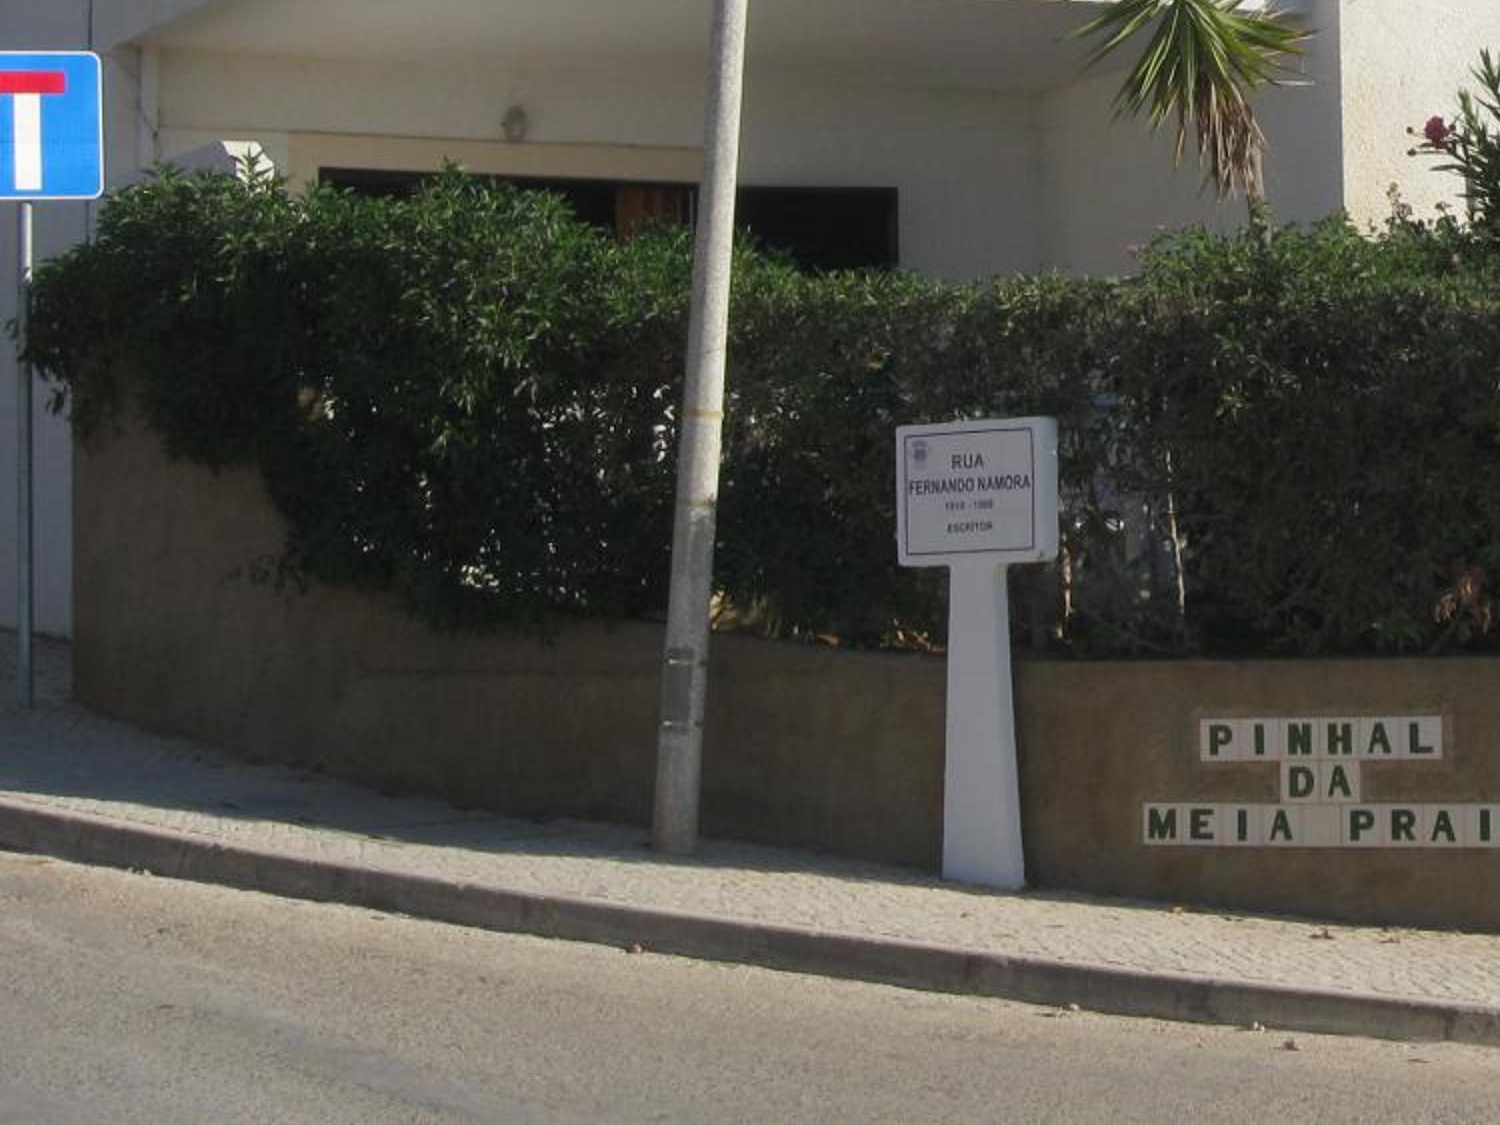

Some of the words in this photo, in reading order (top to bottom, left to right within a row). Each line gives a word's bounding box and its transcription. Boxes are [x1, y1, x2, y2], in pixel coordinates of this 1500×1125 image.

[951, 454, 984, 469] RUA
[909, 478, 975, 495] FERNANDO
[977, 475, 1030, 492] NAMORA
[947, 521, 993, 533] ESCRITOR
[1208, 722, 1434, 755] PINHAL
[1288, 766, 1351, 798] DA
[1147, 808, 1293, 841] MEIA
